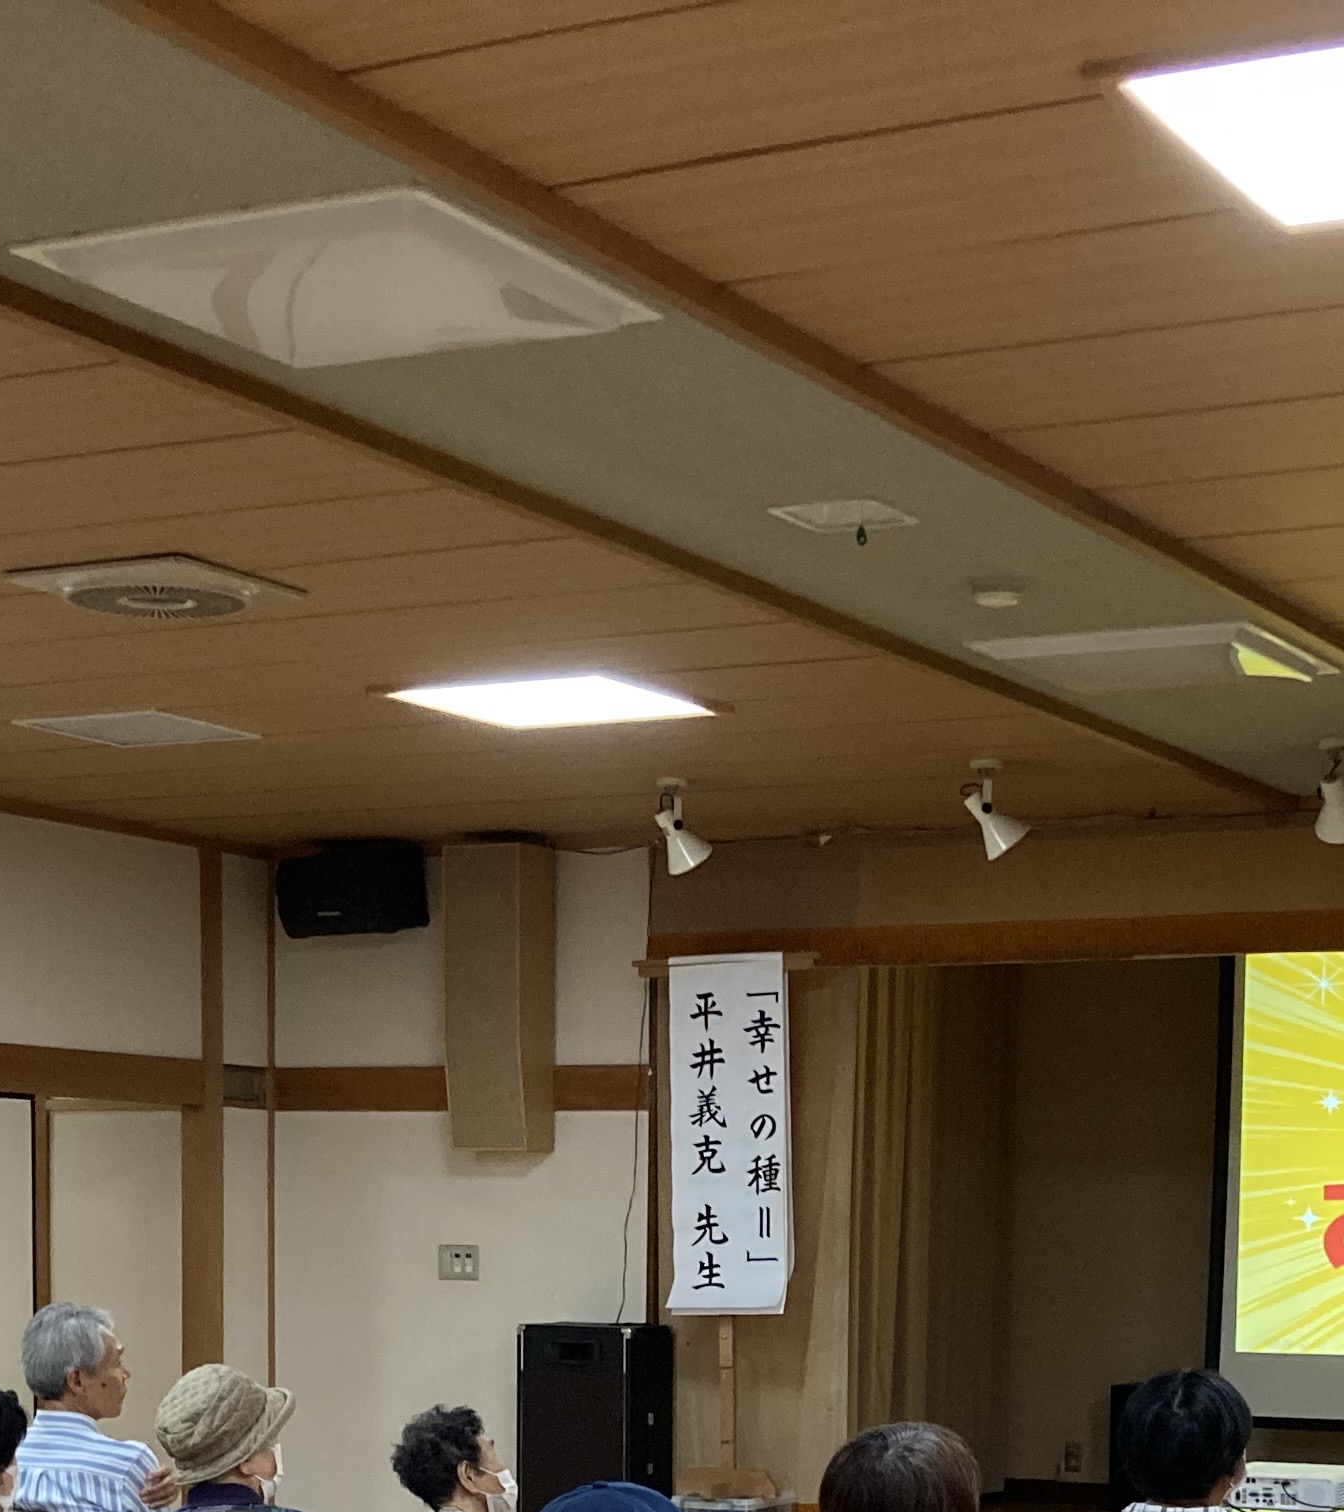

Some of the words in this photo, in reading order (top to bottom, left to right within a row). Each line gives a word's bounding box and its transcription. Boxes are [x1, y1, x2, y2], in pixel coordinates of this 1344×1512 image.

[689, 992, 728, 1176] 平井義克
[691, 1203, 729, 1290] 先生
